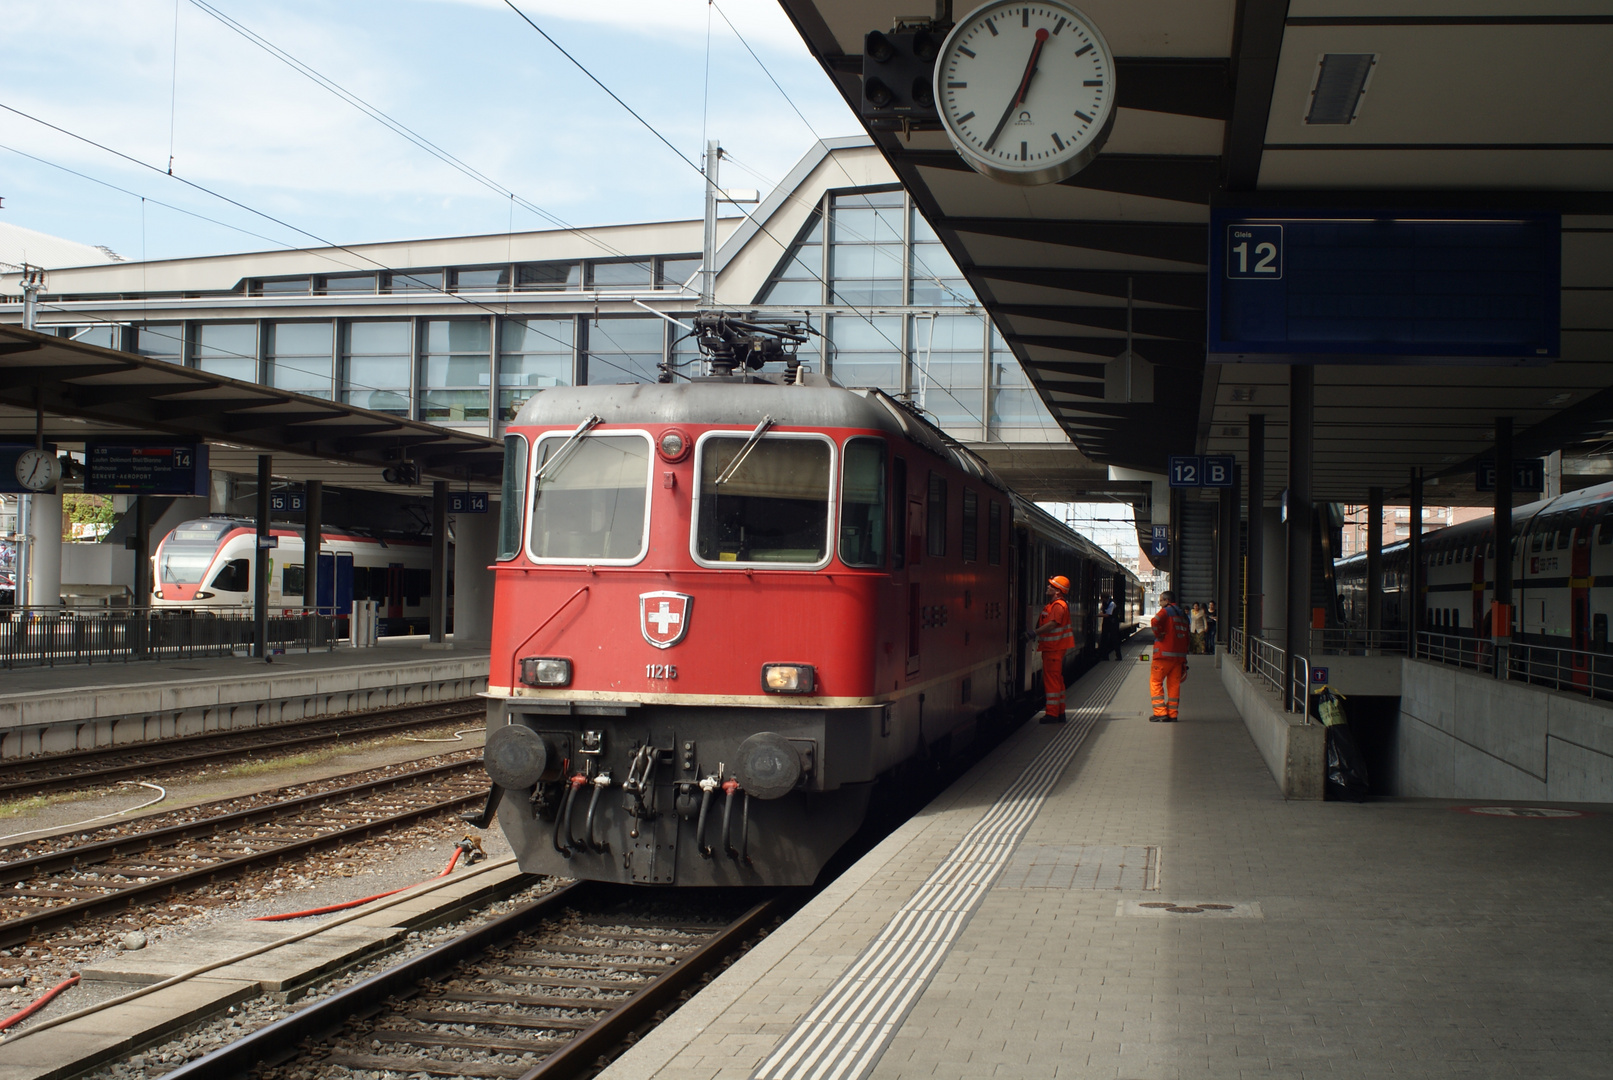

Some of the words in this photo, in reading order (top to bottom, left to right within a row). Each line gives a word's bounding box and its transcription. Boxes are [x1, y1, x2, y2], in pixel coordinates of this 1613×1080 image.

[1233, 242, 1277, 273] 12
[175, 454, 190, 466] 14
[1174, 465, 1196, 482] 12
[1211, 465, 1225, 482] B
[1518, 469, 1534, 486] 11
[272, 497, 284, 509] 15
[292, 497, 301, 509] B
[453, 498, 462, 510] B
[471, 498, 484, 510] 14
[645, 664, 677, 679] 11215
